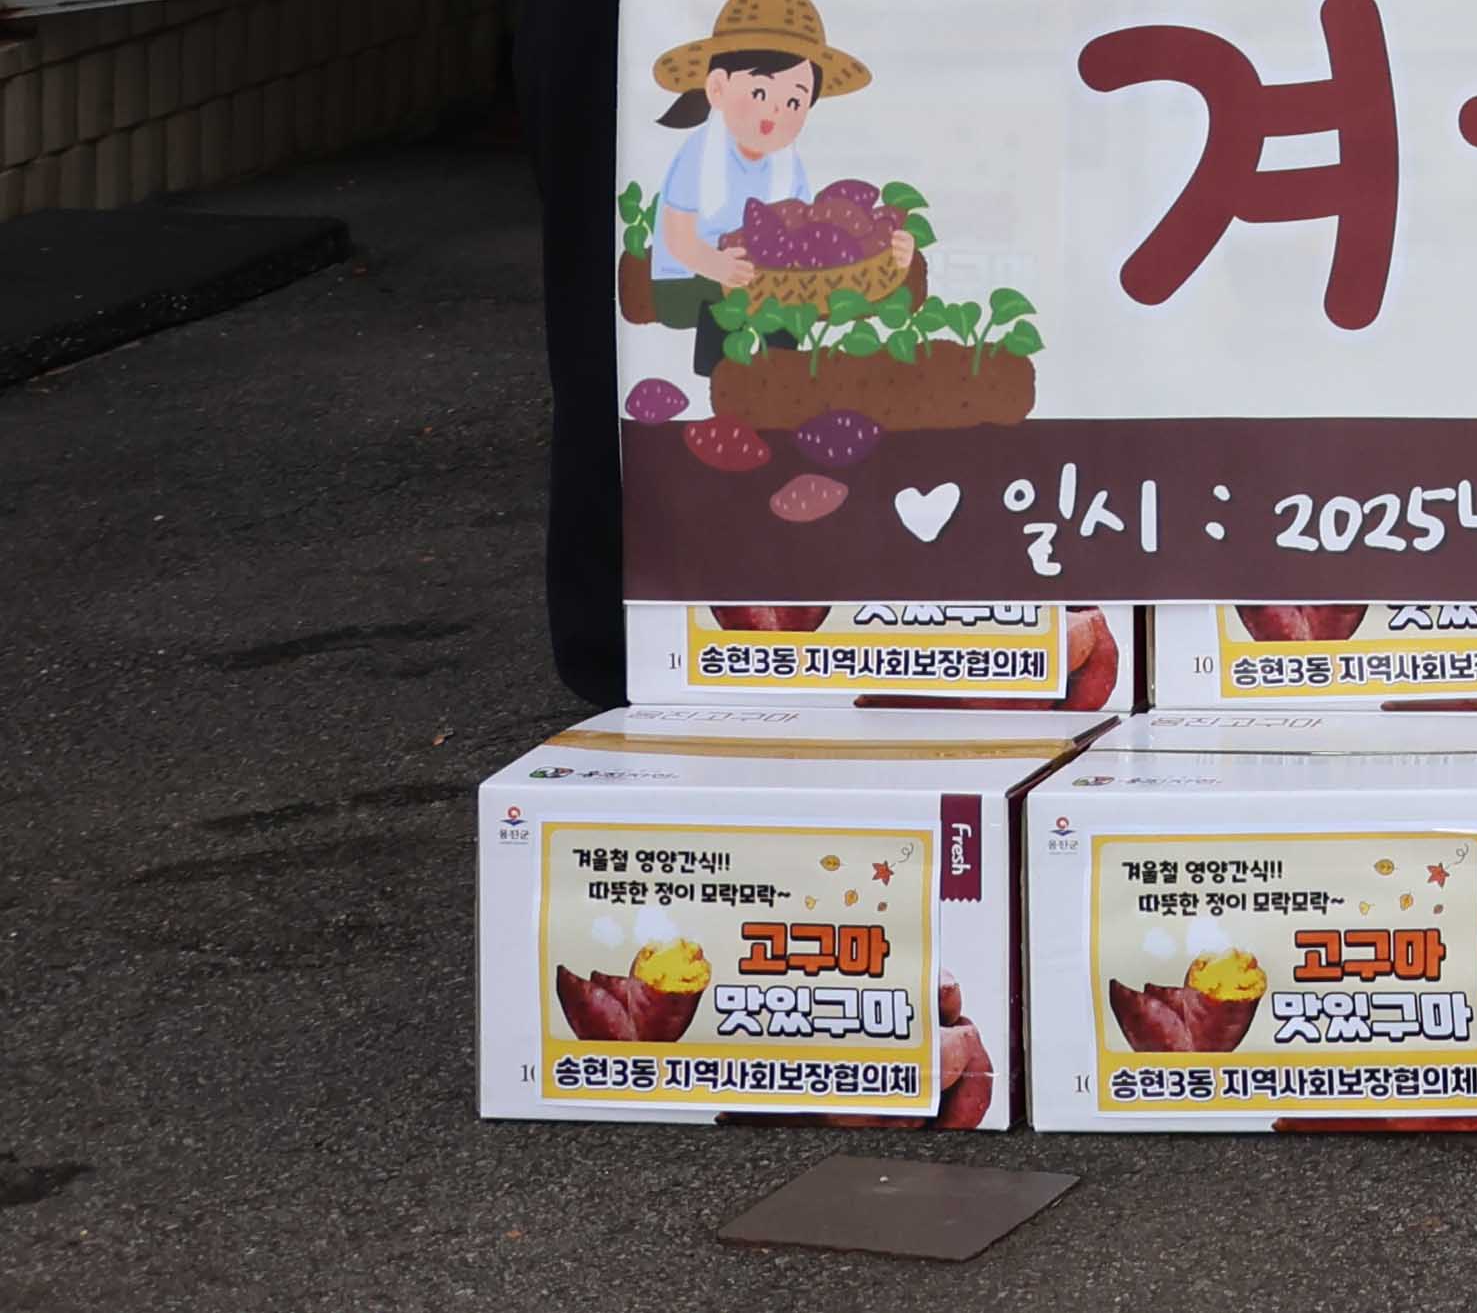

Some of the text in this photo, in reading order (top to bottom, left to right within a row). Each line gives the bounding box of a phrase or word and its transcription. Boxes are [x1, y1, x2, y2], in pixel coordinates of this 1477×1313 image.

[1003, 463, 1157, 576] 일시
[1205, 485, 1230, 540] :
[700, 646, 1045, 678] 송현3동 지역사회보장협의체
[1193, 656, 1214, 674] 10
[1232, 656, 1331, 685] 송현3동
[572, 847, 730, 875] 겨울철 영양간식!!
[951, 822, 972, 876] Fresh
[588, 880, 791, 908] 따뜻한 정이 모락모락~
[741, 922, 890, 978] 고구마
[1296, 928, 1446, 982] 고구마
[716, 985, 914, 1040] 맛있구마
[1271, 991, 1473, 1043] 맛있구마
[555, 1057, 917, 1094] 송현3동 지역사회보장협의체
[1110, 1065, 1477, 1098] 송현3동 지역사회보장협의체
